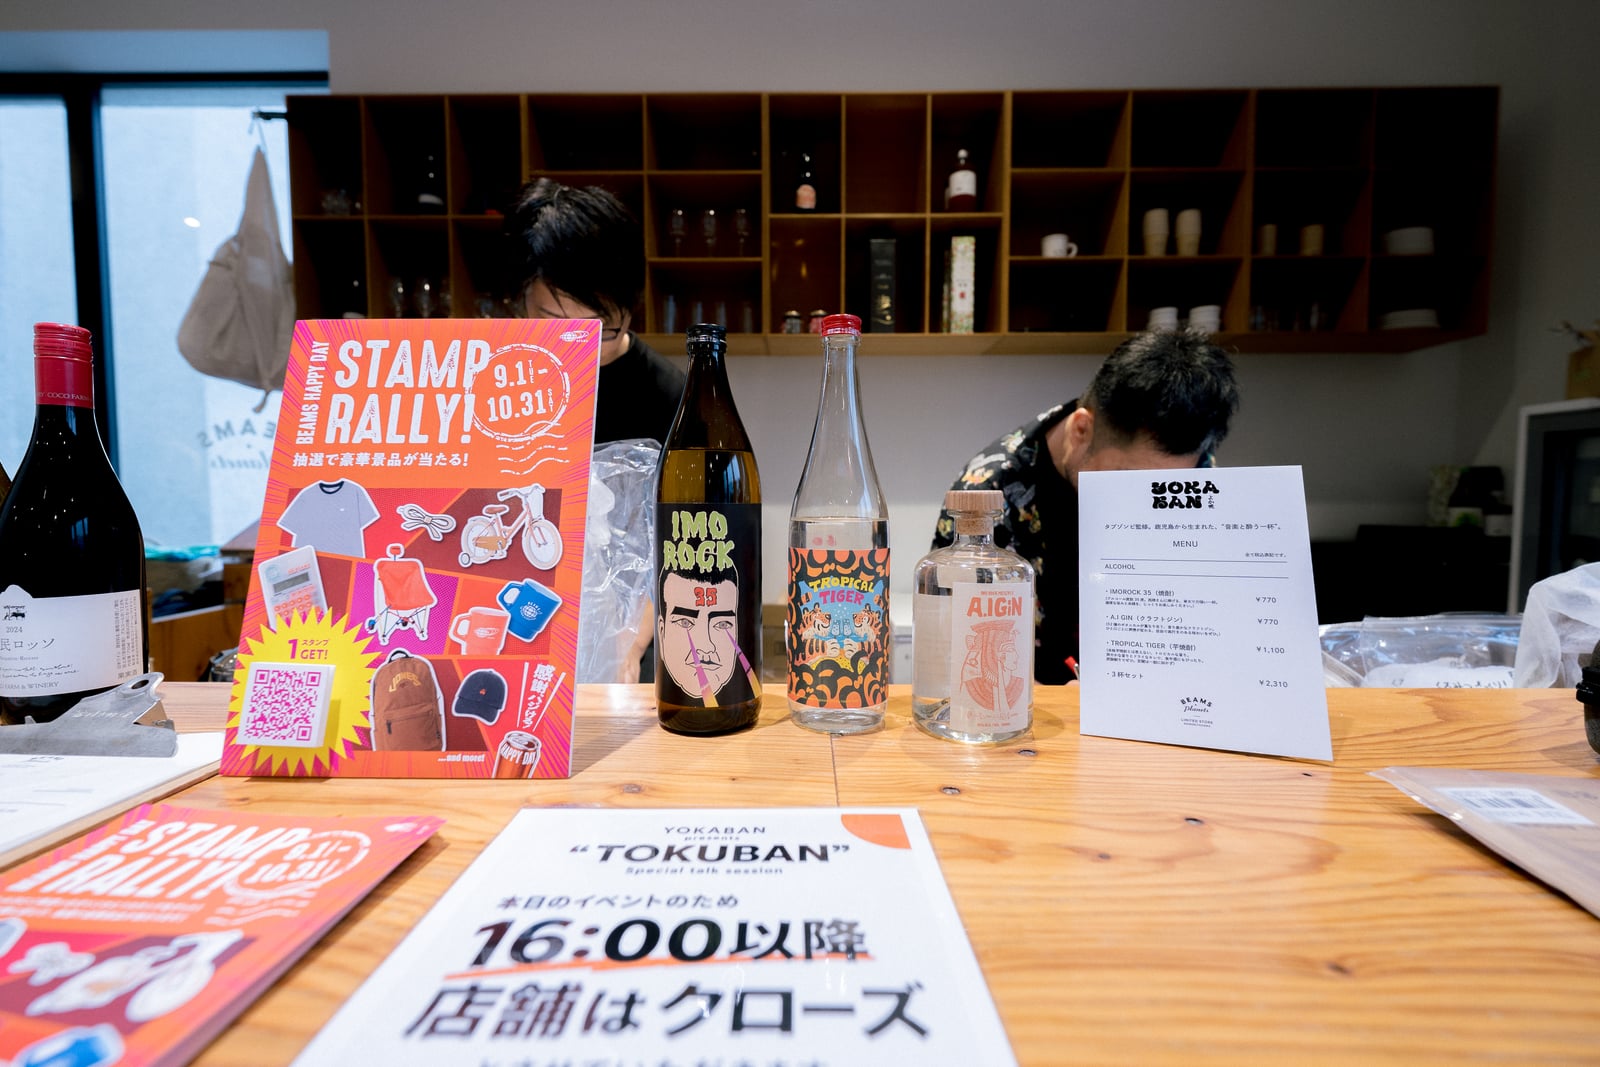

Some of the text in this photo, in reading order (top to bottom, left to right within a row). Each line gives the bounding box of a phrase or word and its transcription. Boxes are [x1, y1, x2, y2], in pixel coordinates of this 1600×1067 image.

[334, 339, 490, 389] STAMP
[493, 360, 527, 388] 9.1
[47, 391, 70, 400] COCO
[295, 341, 330, 445] BEAMS HAPPY DAY
[487, 389, 547, 423] 10.31
[324, 393, 477, 444] RALLY!
[292, 452, 469, 467] 抽選で豪華景品が当たる!
[1151, 480, 1220, 495] YOKA
[1152, 495, 1202, 509] BAN
[671, 510, 729, 541] IMO
[1172, 540, 1199, 548] MENU
[663, 540, 735, 573] ROCK
[808, 576, 875, 593] TROPICAL
[693, 586, 718, 607] 35
[819, 590, 865, 605] TIGER
[1255, 596, 1277, 604] ¥770
[6, 626, 23, 634] 2024
[1257, 618, 1279, 626] ¥770
[288, 638, 329, 660] 1 スタンプ
[300, 649, 329, 660] GET!
[1180, 696, 1213, 708] BEAMS
[664, 826, 767, 835] YOKABAN
[120, 820, 312, 862] STAMP
[625, 866, 684, 876] Special
[725, 867, 784, 875] session
[496, 895, 740, 911] 本日のイベントのため
[470, 917, 869, 967] 16:00以降
[404, 981, 931, 1041] 店舗はクローズ
